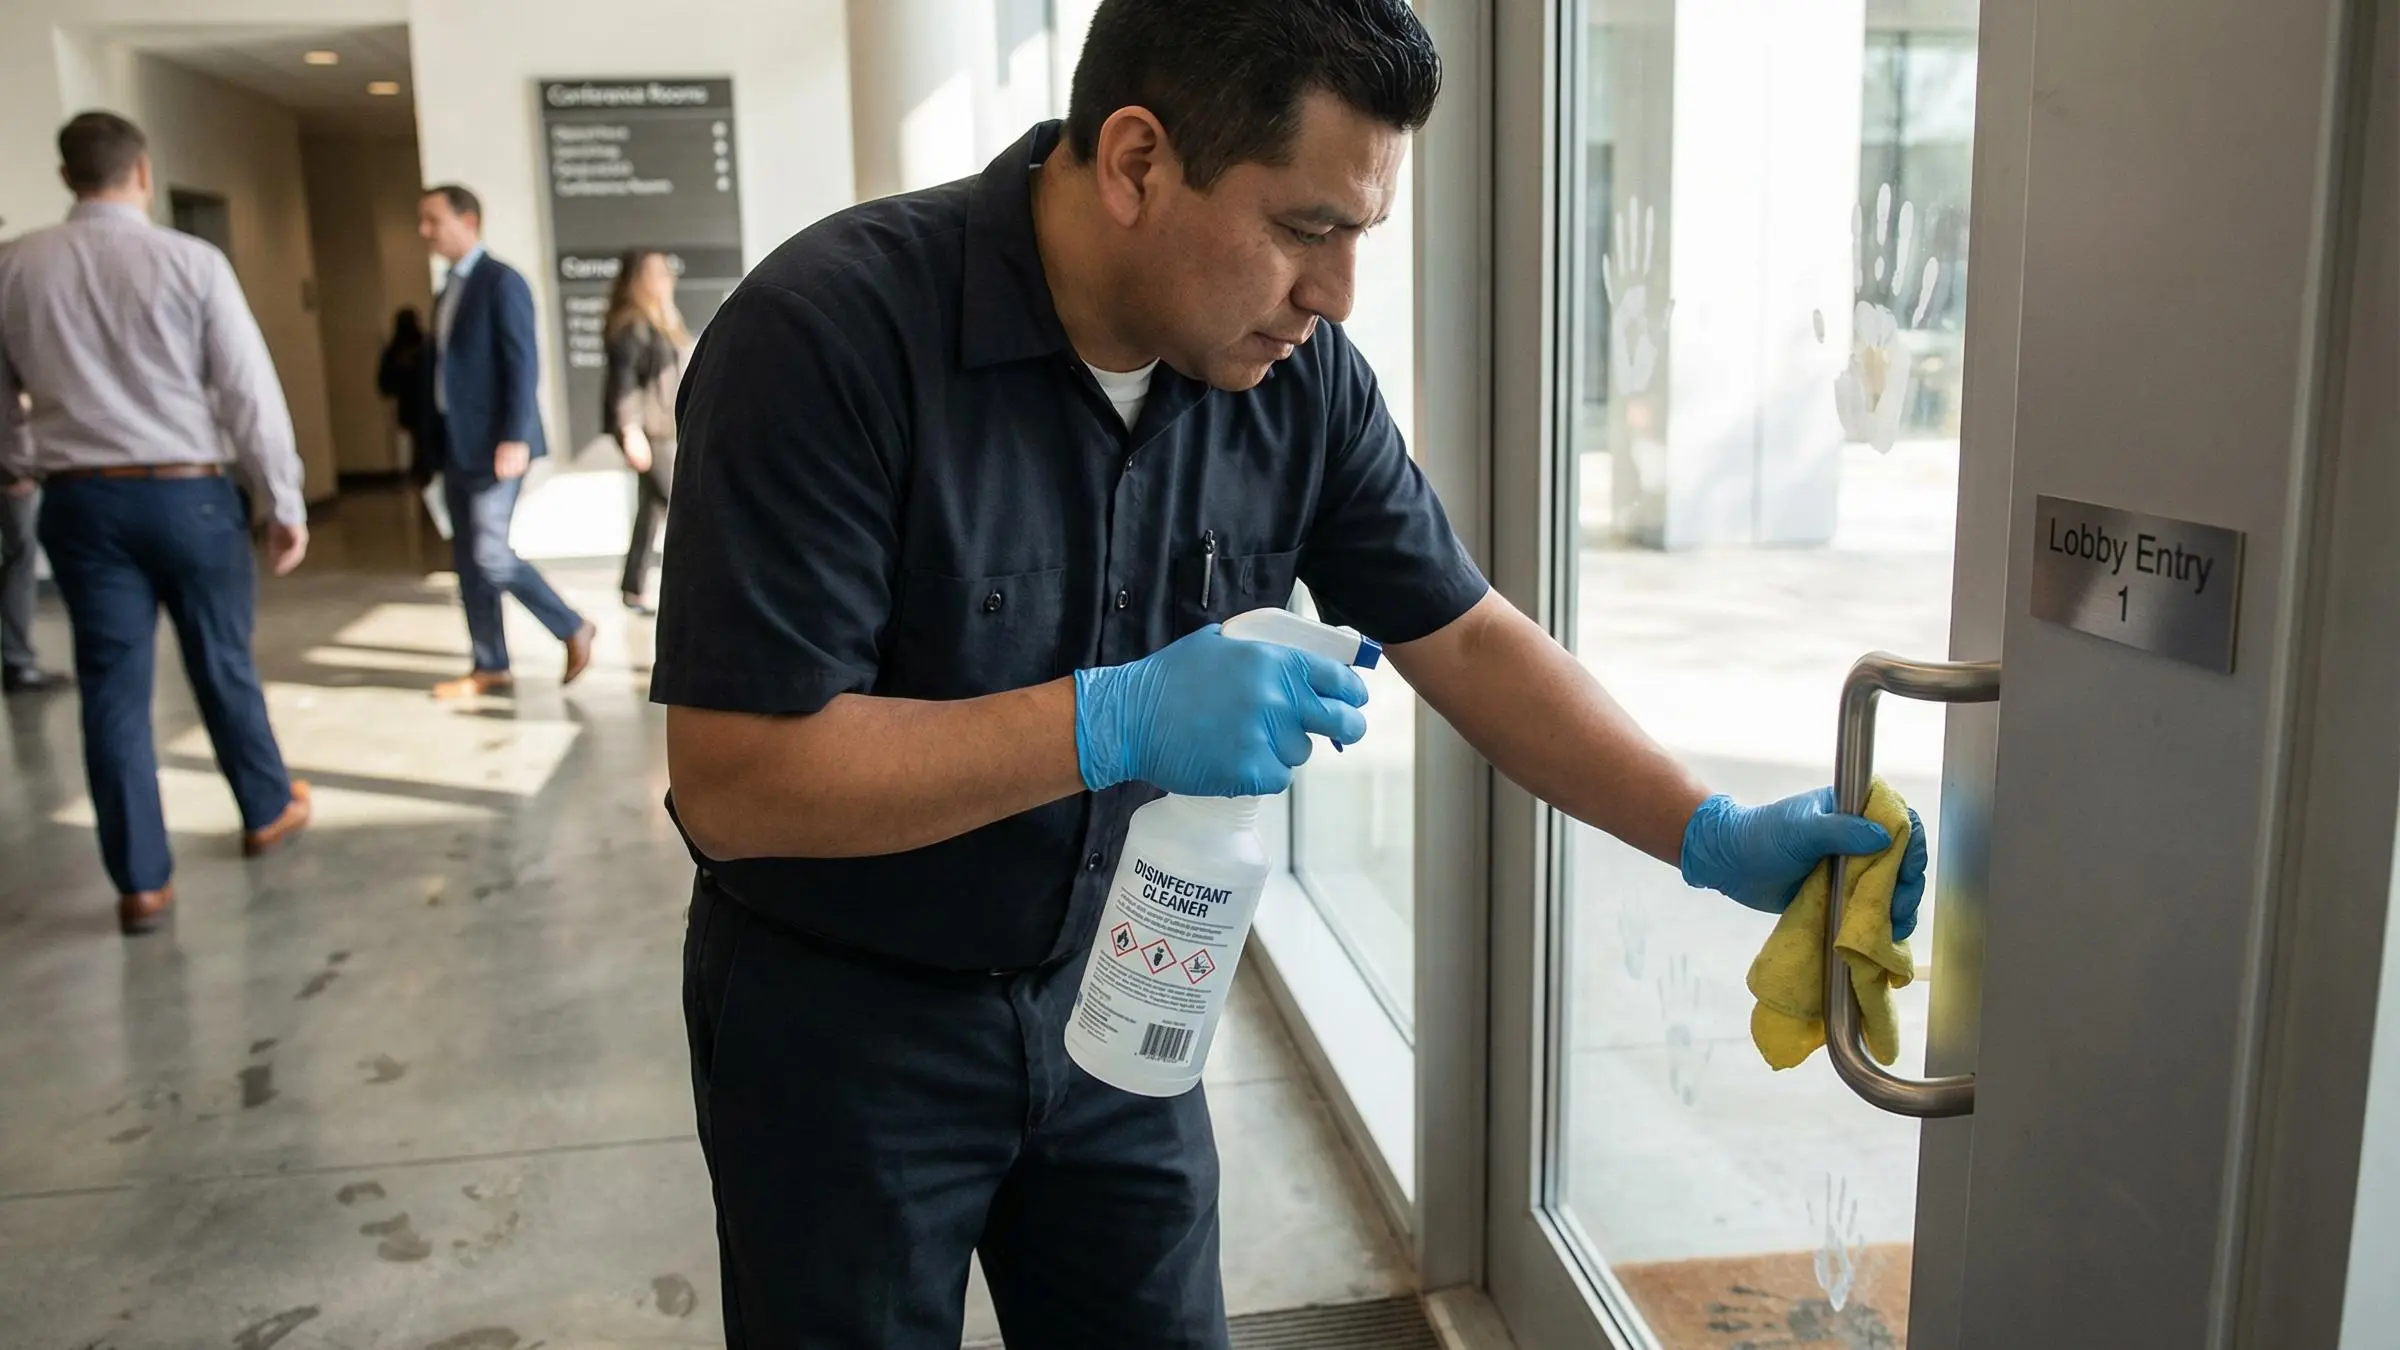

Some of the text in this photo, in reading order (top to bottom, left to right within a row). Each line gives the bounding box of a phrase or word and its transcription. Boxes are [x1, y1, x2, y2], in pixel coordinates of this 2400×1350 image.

[547, 83, 708, 107] Conference Rooms
[2050, 517, 2214, 595] Lobby Entry
[2118, 585, 2129, 622] 1
[1134, 858, 1232, 905] DISINFECTANT
[1142, 884, 1209, 919] CLEANER
